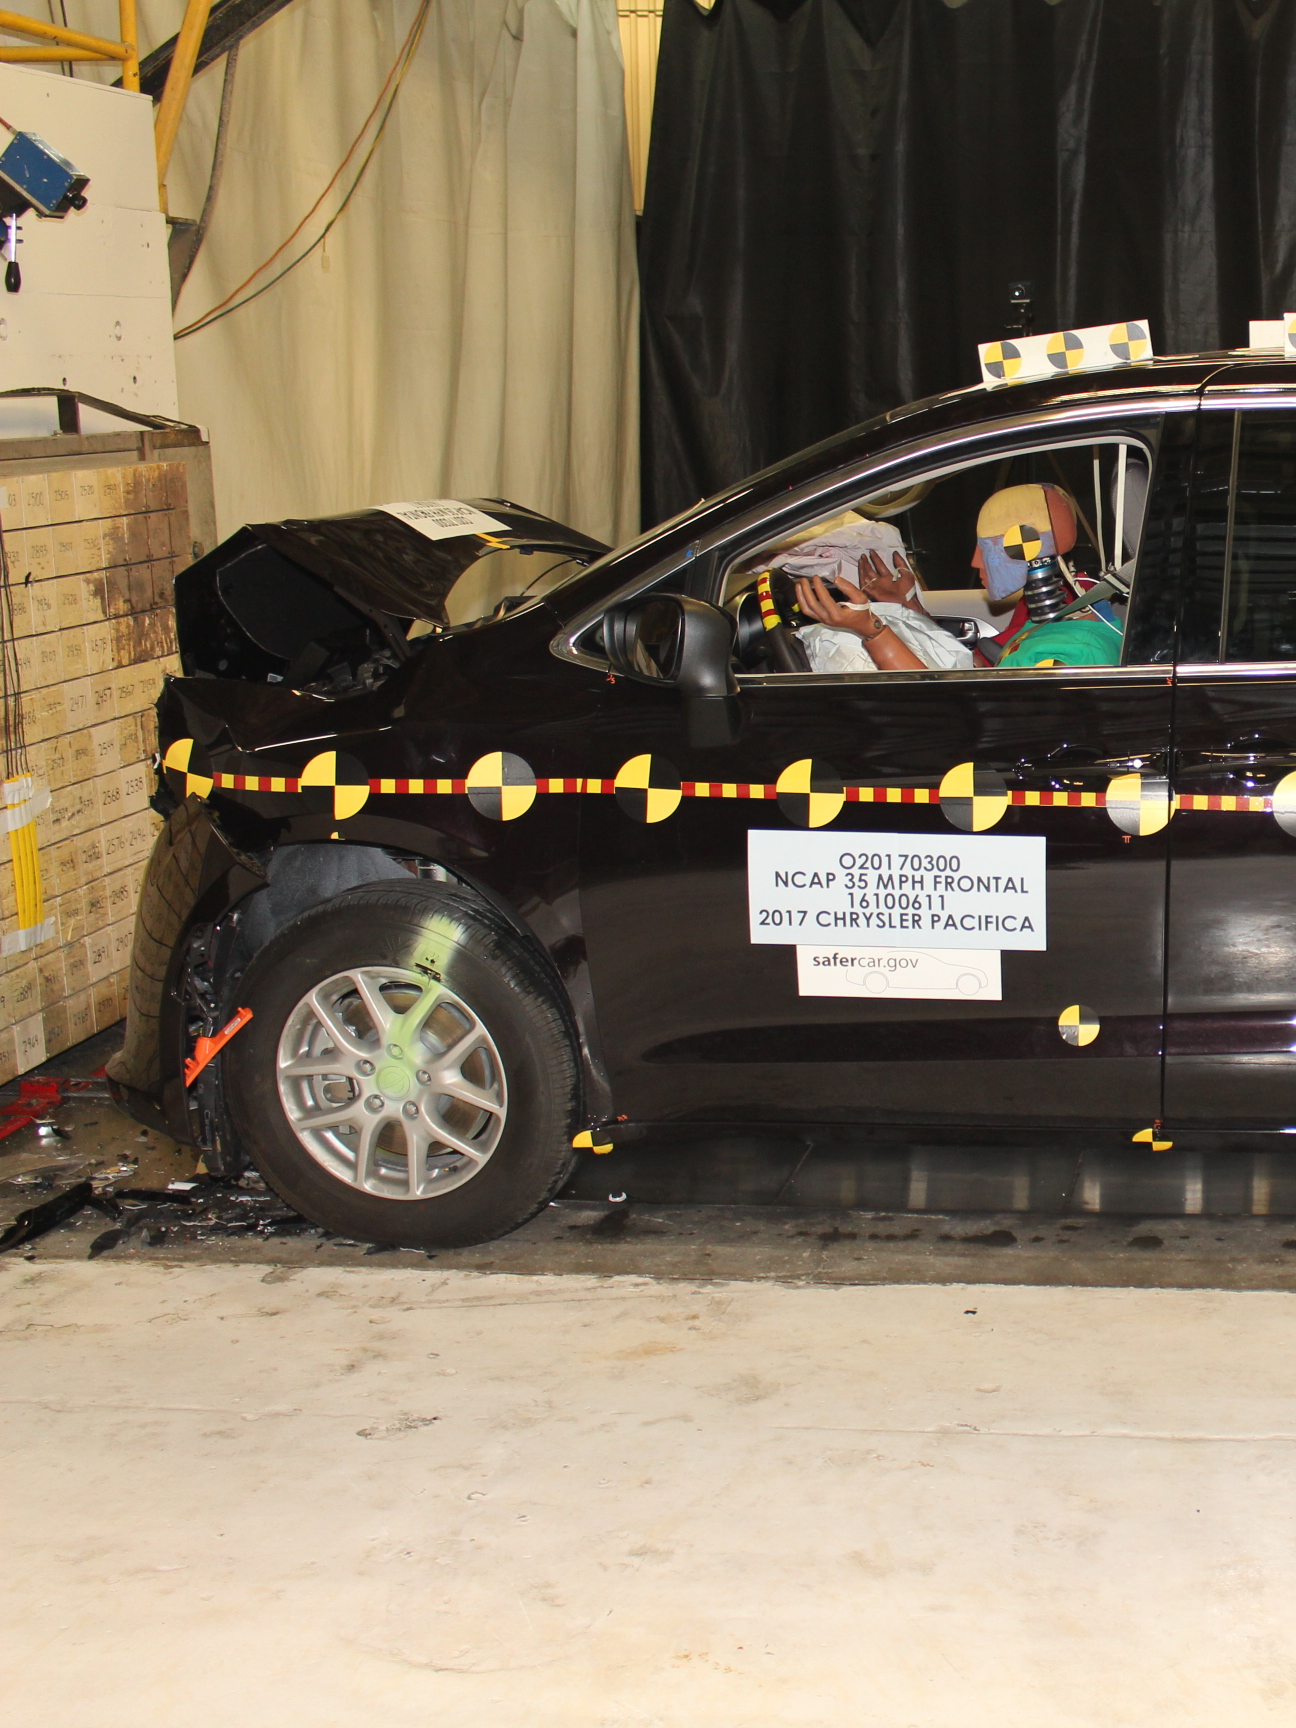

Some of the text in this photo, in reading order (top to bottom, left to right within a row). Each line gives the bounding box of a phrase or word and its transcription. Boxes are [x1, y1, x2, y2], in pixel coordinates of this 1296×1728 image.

[102, 787, 121, 806] 2568
[774, 871, 1029, 894] NCAP 35 MPH FRONTAL
[848, 892, 945, 911] 16100611
[758, 909, 1035, 933] 2017 CHRYSLER PACIFICA
[812, 952, 919, 972] safercar.gov
